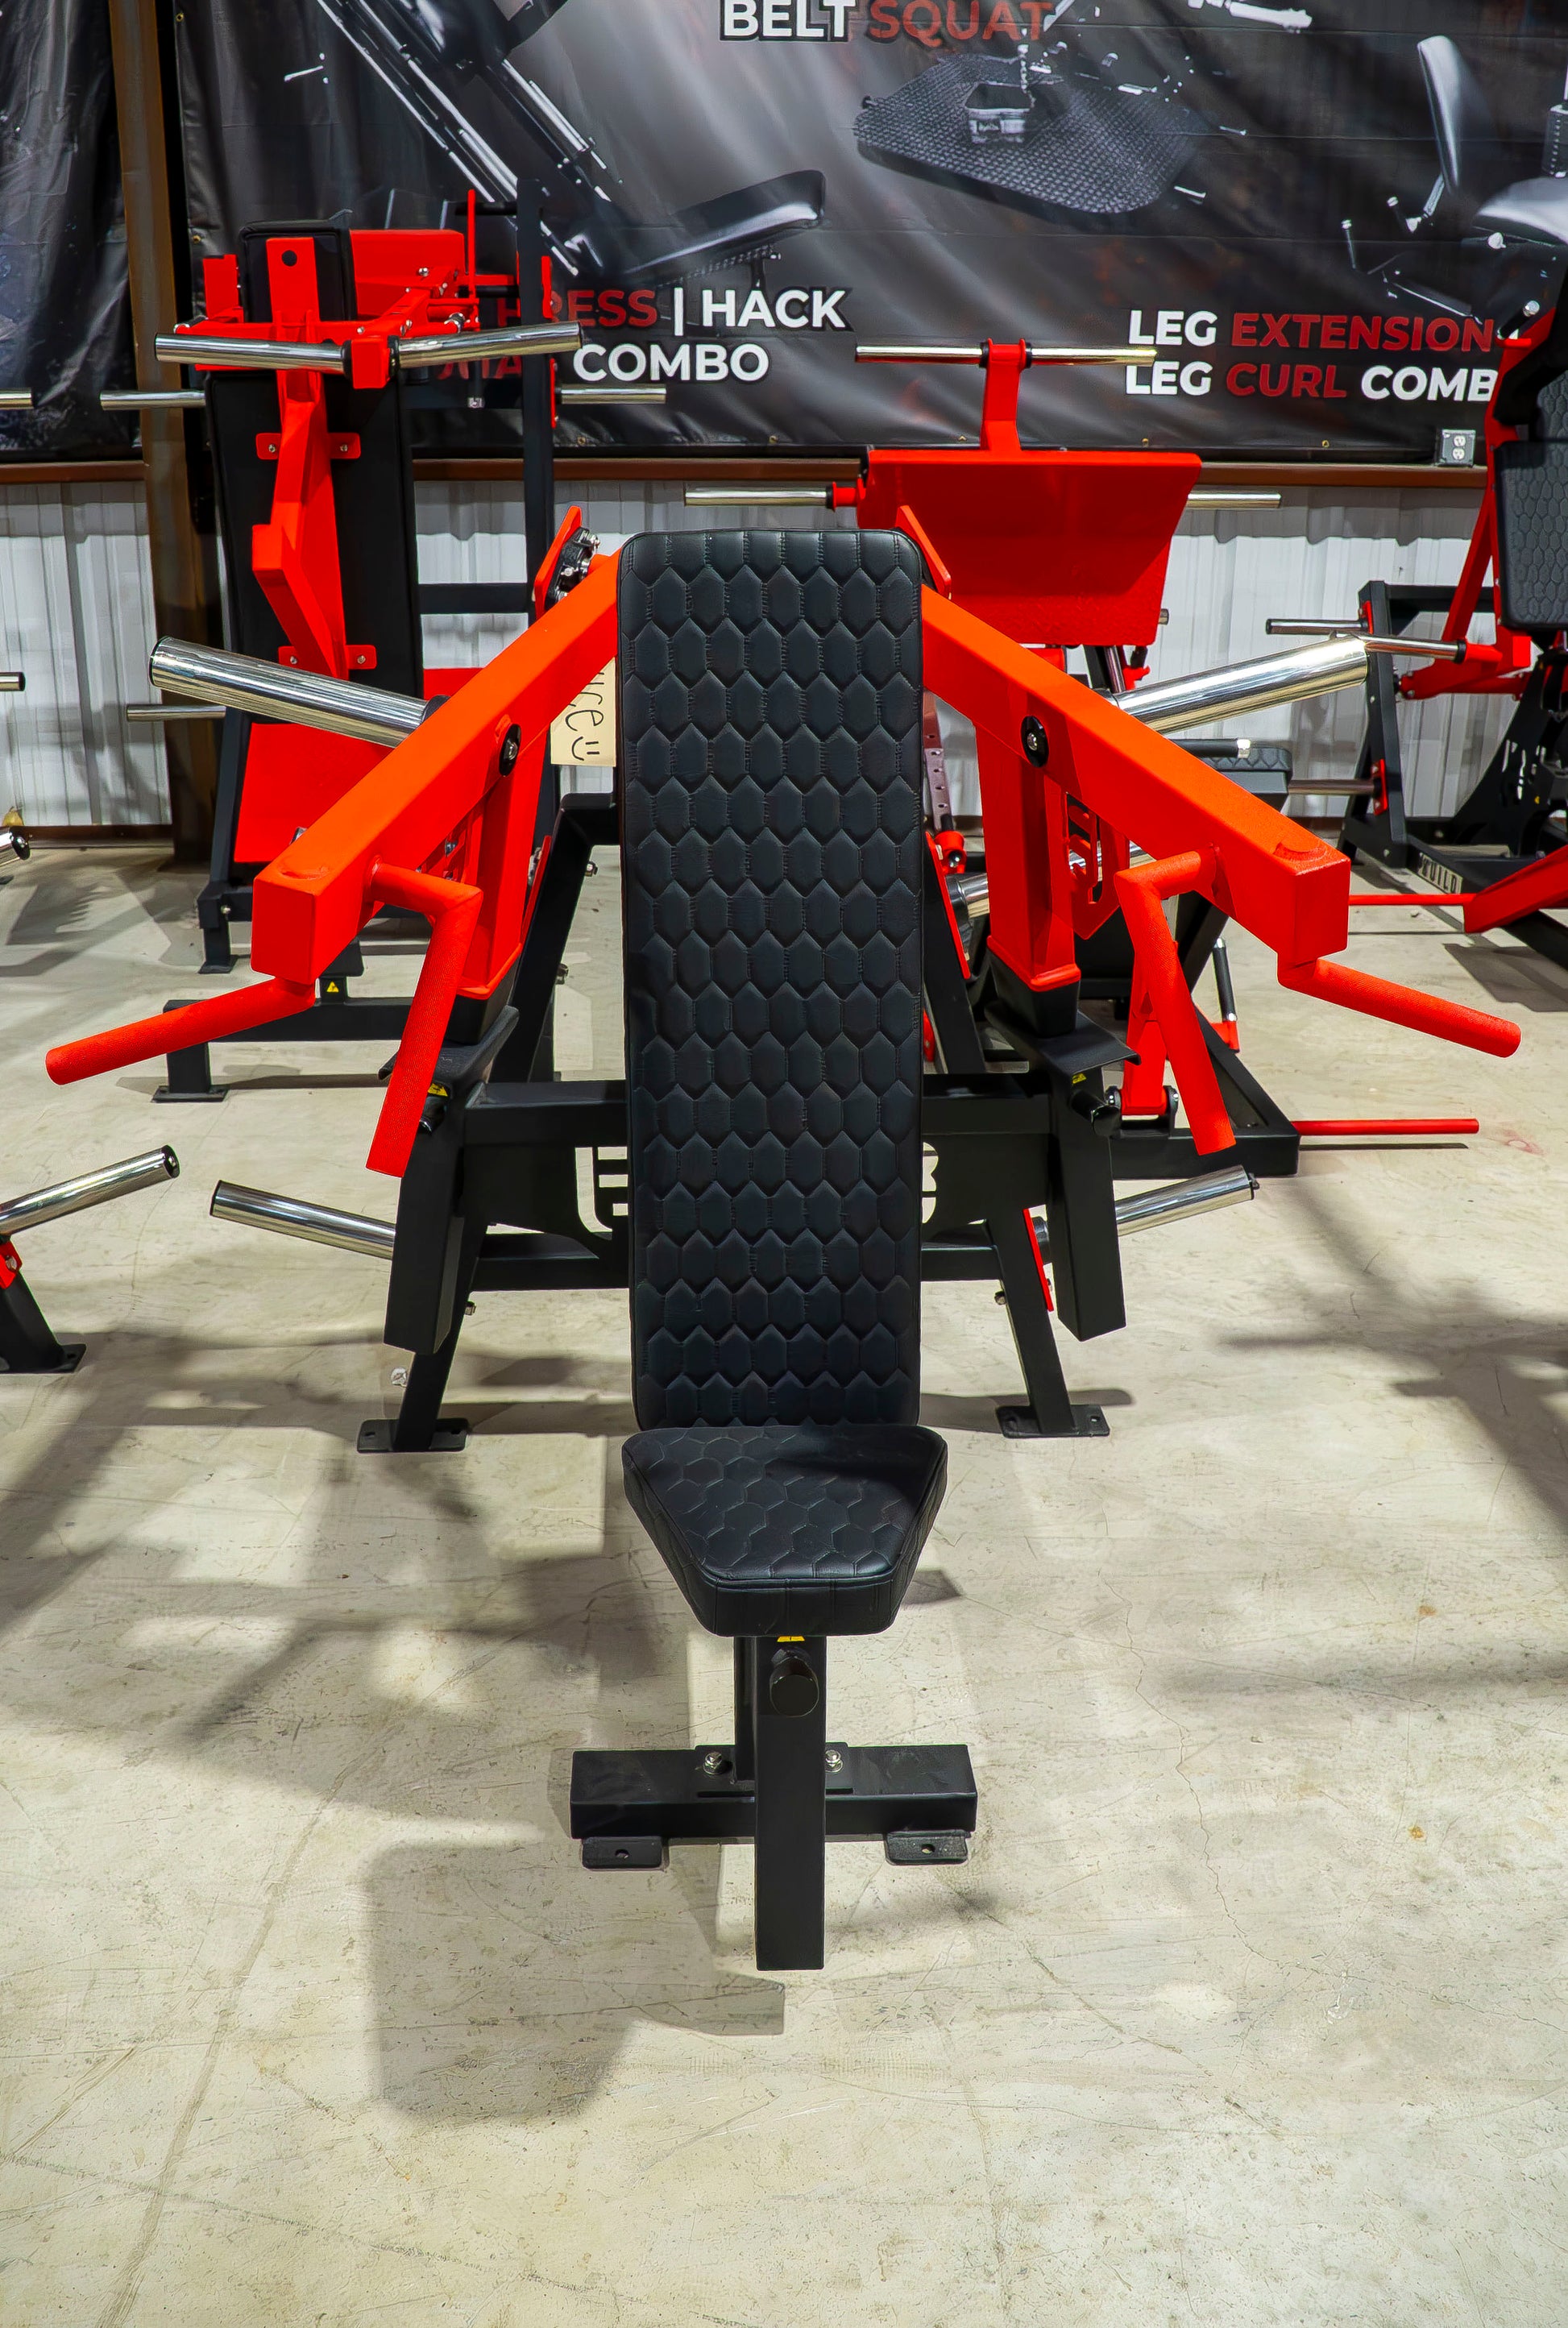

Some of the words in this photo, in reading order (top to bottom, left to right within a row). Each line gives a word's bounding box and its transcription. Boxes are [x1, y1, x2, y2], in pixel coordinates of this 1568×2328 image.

[724, 0, 857, 38] BELT
[866, 0, 1054, 47] SQUAT
[702, 289, 846, 328] HACK
[1129, 309, 1217, 347] LEG
[1231, 313, 1495, 352] EXTENSION
[573, 343, 769, 381] COMBO
[1126, 361, 1213, 396] LEG
[1226, 363, 1347, 397] CURL
[1361, 365, 1499, 402] COMB
